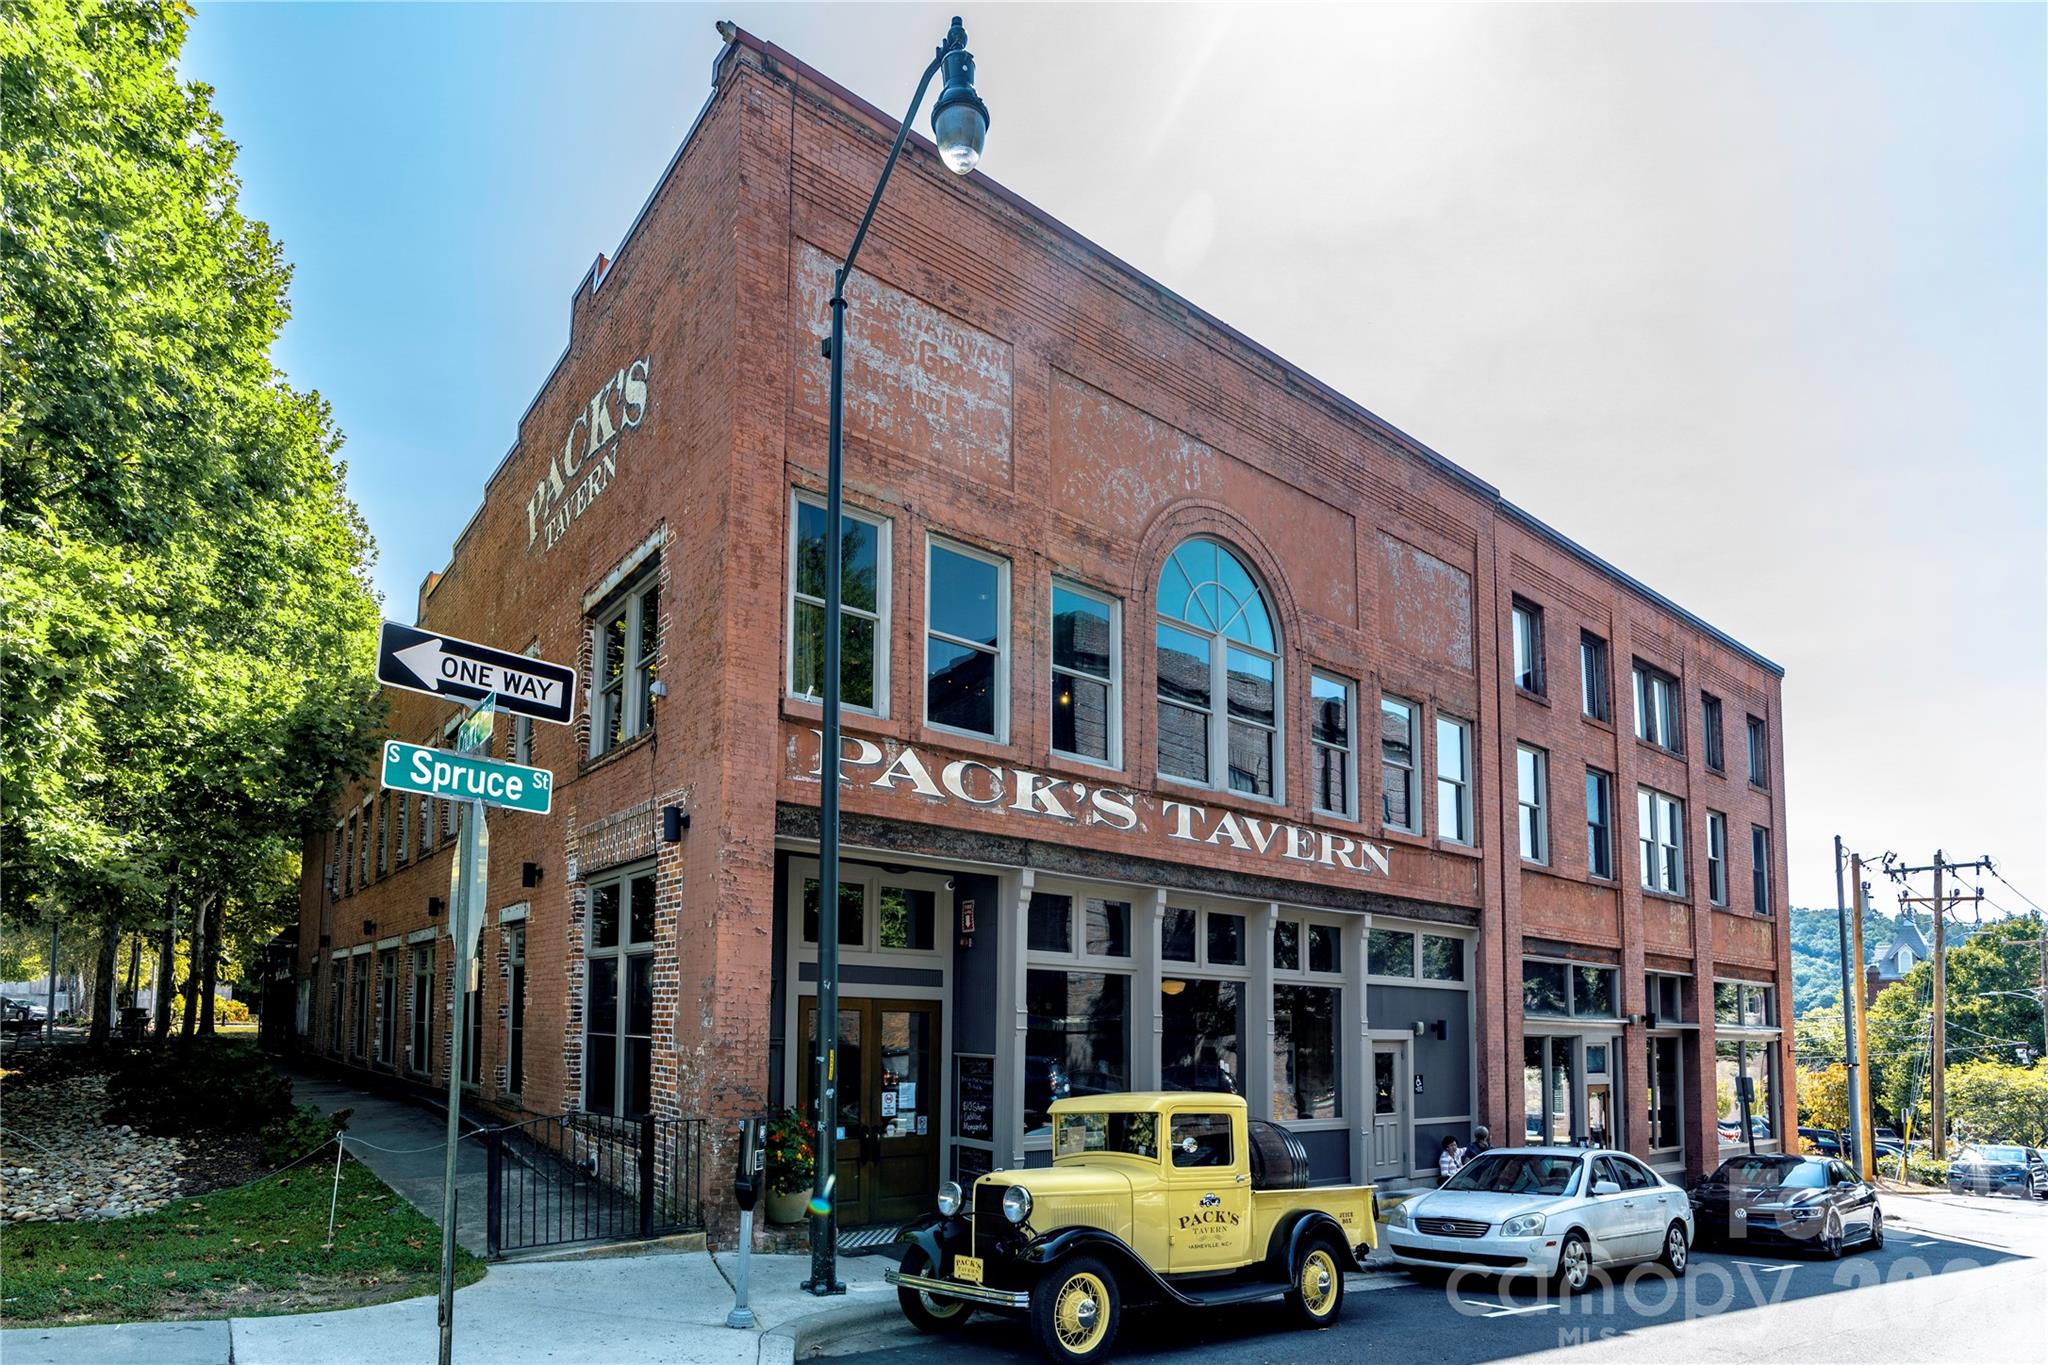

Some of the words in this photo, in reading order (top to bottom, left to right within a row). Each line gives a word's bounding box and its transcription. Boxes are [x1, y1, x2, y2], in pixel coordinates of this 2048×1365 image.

[527, 355, 651, 551] PACK'S
[544, 442, 619, 551] TAVERN
[441, 657, 493, 688] ONE
[504, 671, 554, 701] WAY
[388, 745, 400, 763] S
[410, 750, 523, 800] Spruce
[532, 771, 550, 790] St
[809, 729, 1138, 831] PACK'S
[1162, 800, 1395, 877] TAVERN
[1178, 1210, 1240, 1230] PACK'S
[1192, 1226, 1227, 1234] TAVERN
